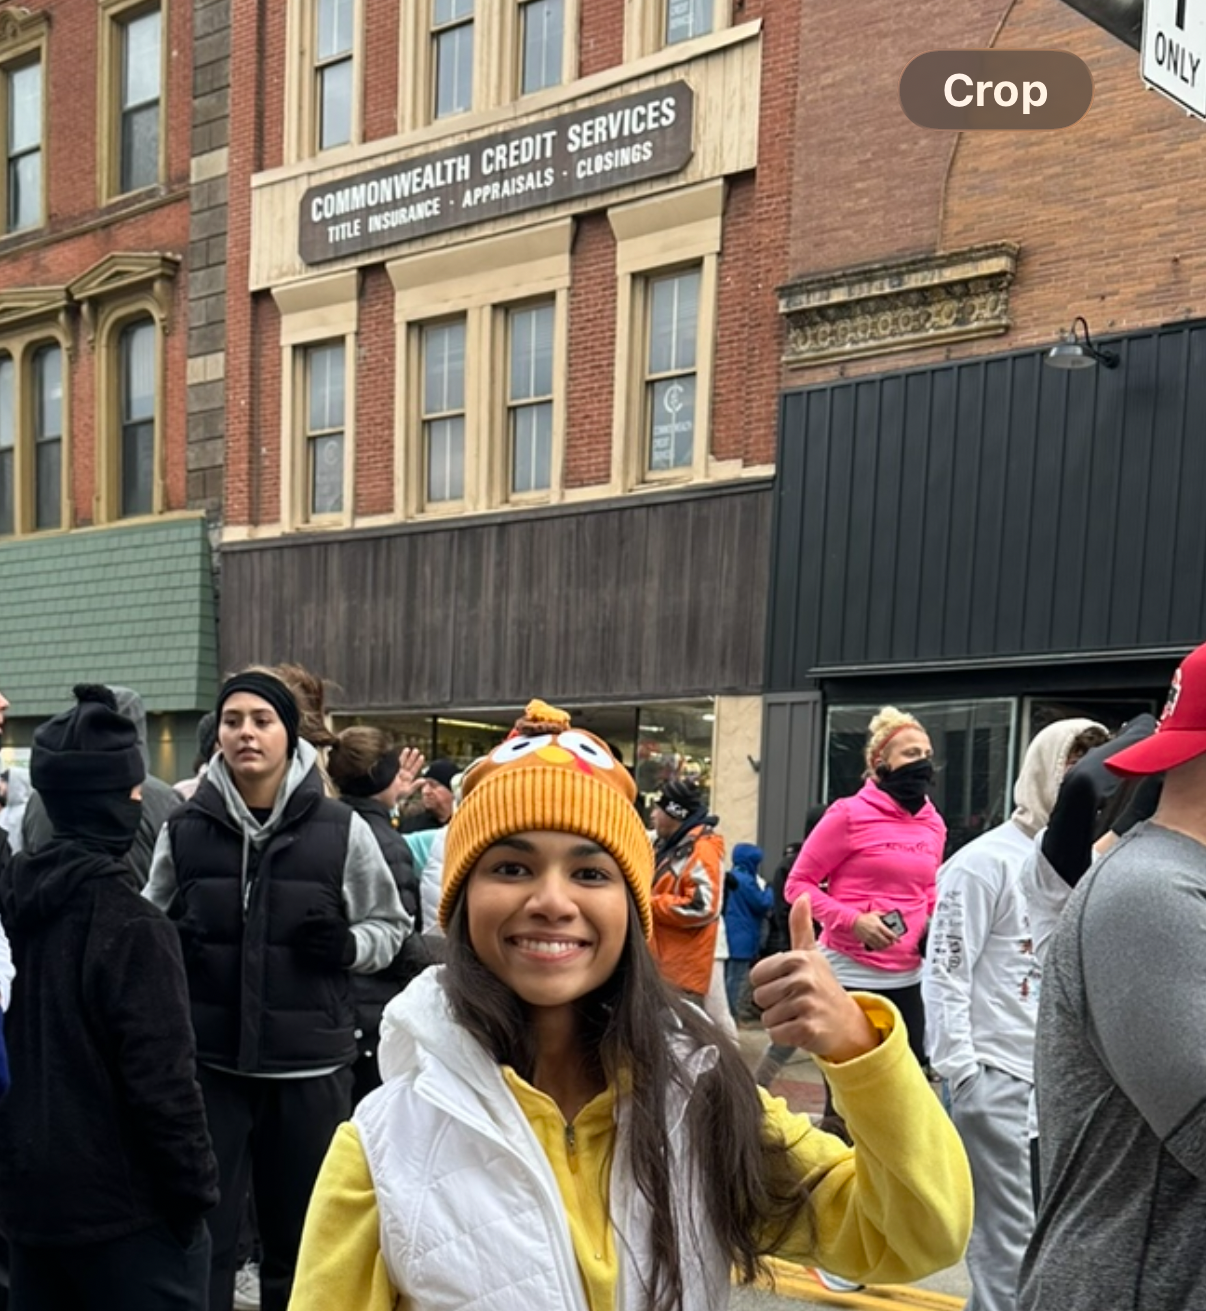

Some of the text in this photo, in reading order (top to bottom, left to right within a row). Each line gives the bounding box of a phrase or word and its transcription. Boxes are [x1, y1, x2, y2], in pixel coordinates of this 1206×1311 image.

[1155, 31, 1201, 88] ONLY
[311, 96, 676, 222] COMMONWEALTH CREDIT SERVICES
[327, 141, 653, 244] TITLE INSURANCE APPRAISALS CLOSINGS
